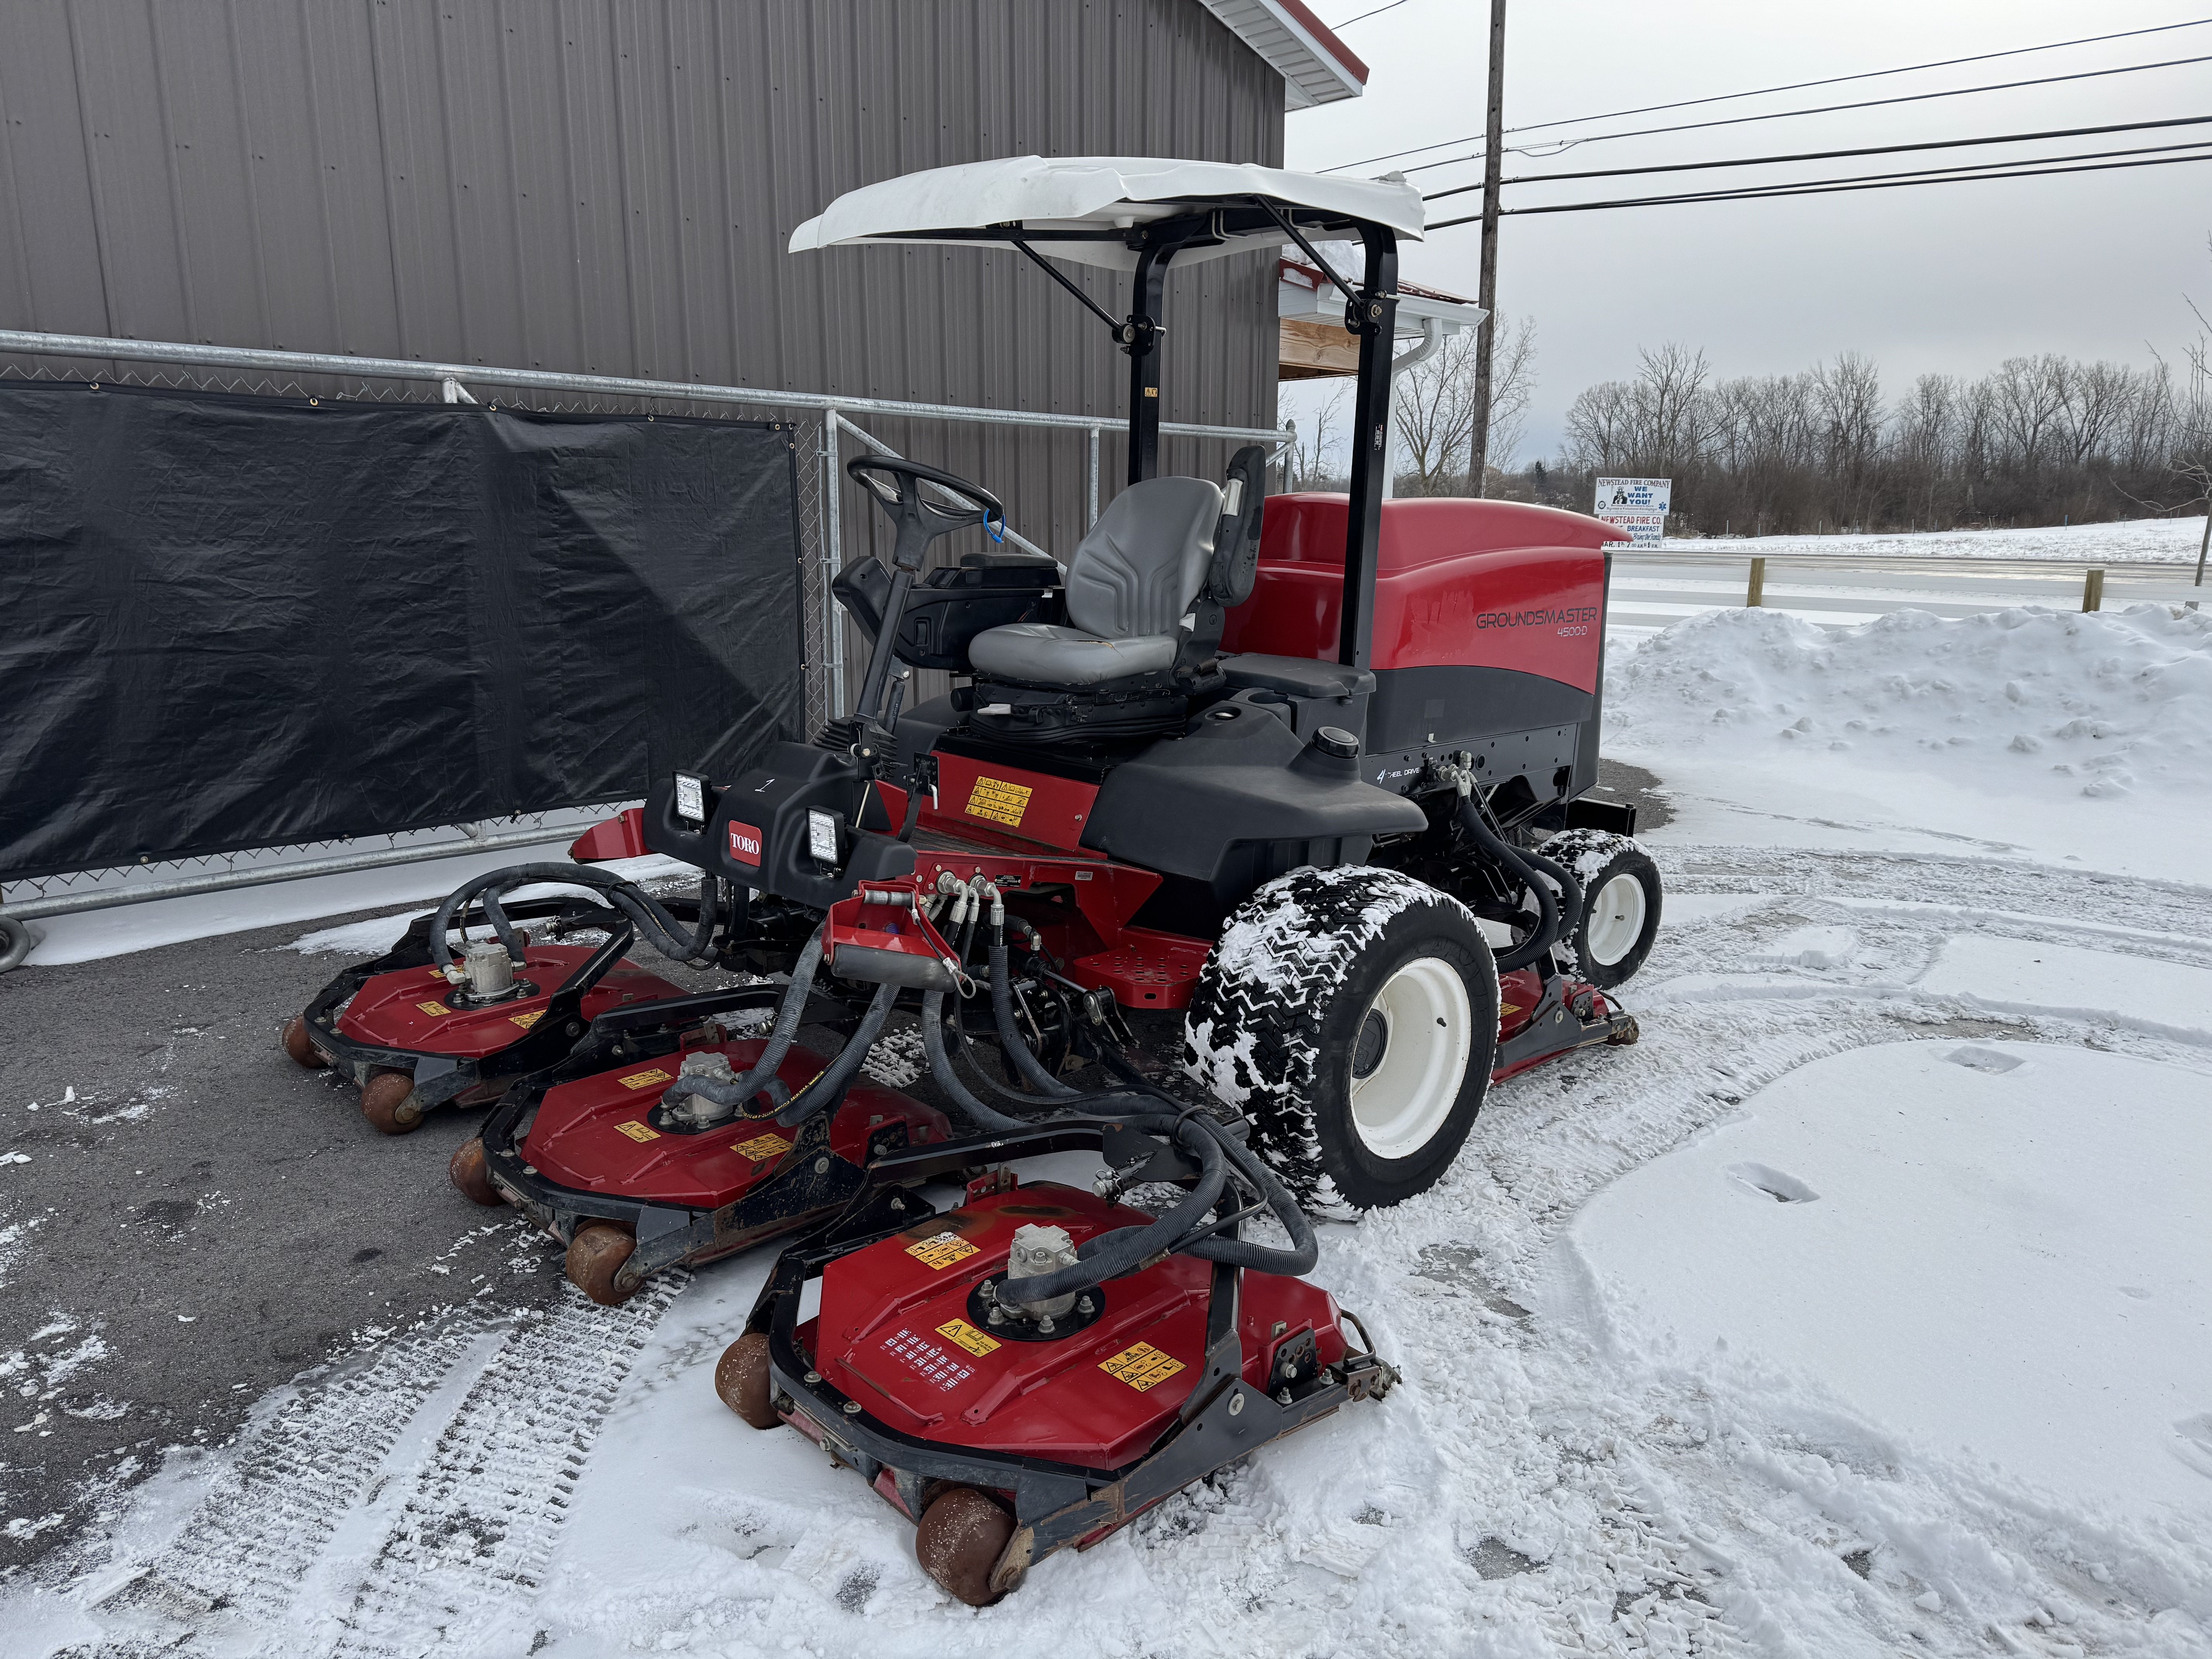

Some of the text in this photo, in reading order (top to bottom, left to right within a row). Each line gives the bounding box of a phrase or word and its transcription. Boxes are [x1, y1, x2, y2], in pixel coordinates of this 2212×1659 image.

[1598, 479, 1628, 488] NEWSTEAD
[1644, 480, 1670, 488] COMPANY
[1476, 606, 1598, 629] GROUNDSMASTER
[1557, 625, 1587, 637] 4500-D
[1404, 767, 1420, 776] DRIVE
[730, 832, 760, 855] TORO
